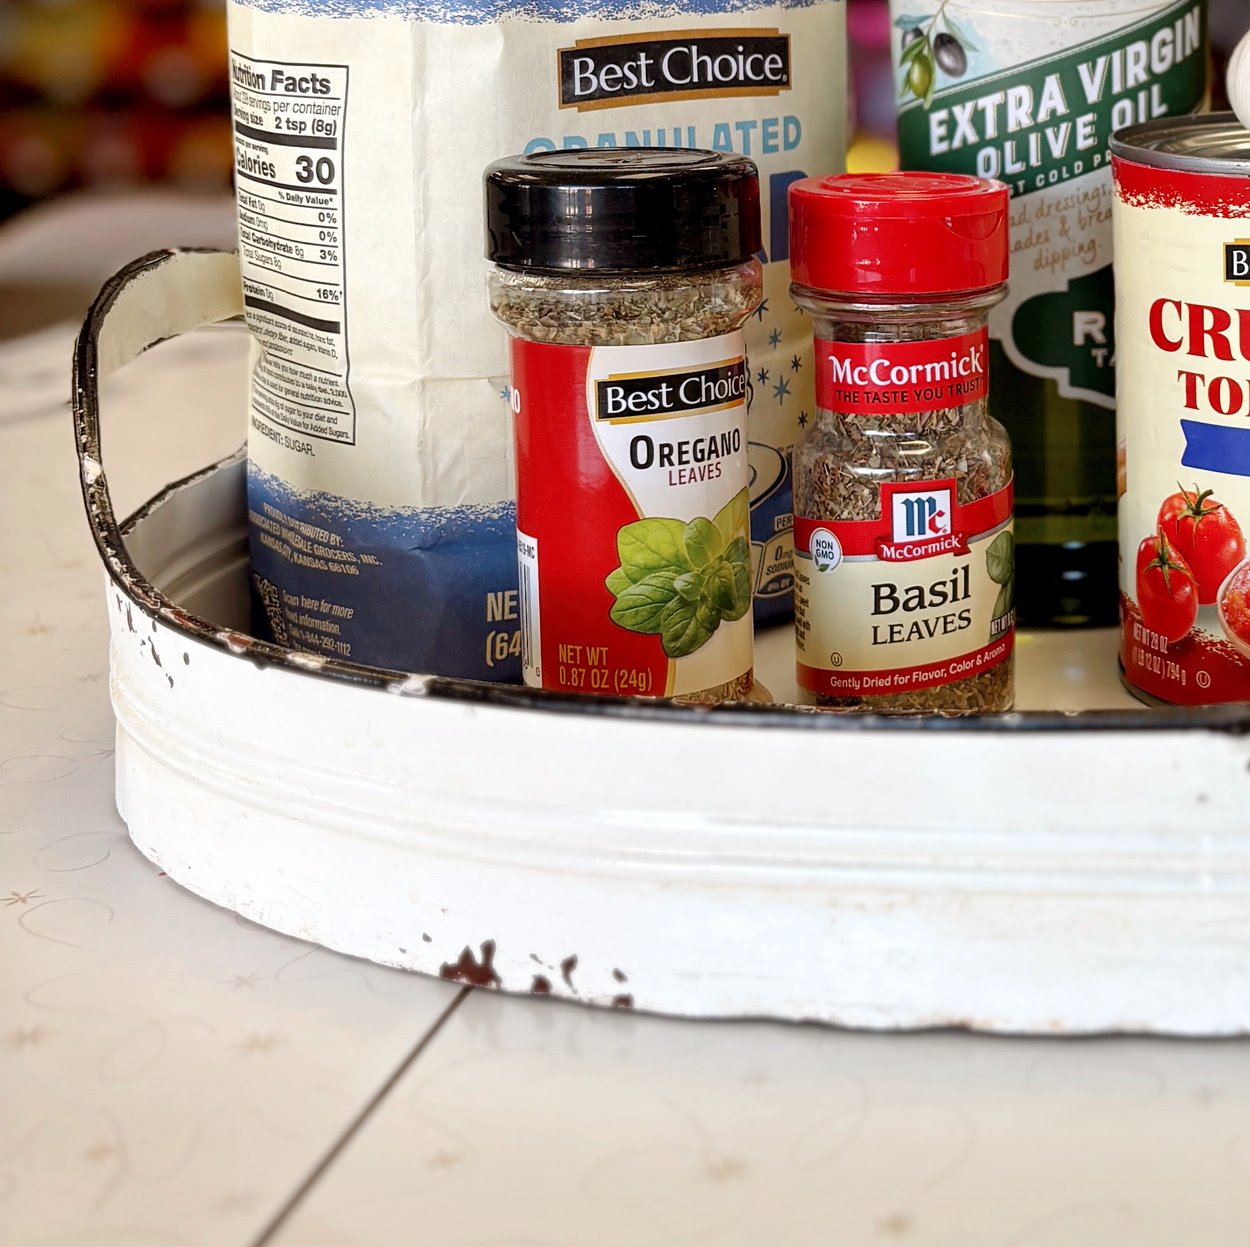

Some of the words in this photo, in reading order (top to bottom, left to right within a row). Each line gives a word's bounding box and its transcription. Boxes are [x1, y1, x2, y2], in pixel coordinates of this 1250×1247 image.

[270, 69, 331, 95] Facts
[573, 52, 655, 96] Best
[929, 73, 1070, 156] EXTRA
[1077, 5, 1200, 105] VIRGIN
[292, 101, 341, 116] container
[274, 116, 283, 130] 2
[285, 117, 307, 134] tsp
[311, 118, 337, 136] (8g)
[976, 113, 1098, 179] OLIVE
[1111, 83, 1168, 132] OIL
[295, 155, 335, 184] 30
[1036, 160, 1083, 187] COLD
[318, 212, 337, 224] 0%
[319, 231, 337, 243] 0%
[320, 250, 338, 261] 3%
[606, 382, 673, 414] Best
[836, 389, 859, 403] THE
[864, 389, 908, 403] TASTE
[913, 387, 943, 401] YOU
[668, 462, 722, 487] LEAVES
[815, 539, 833, 550] NON
[815, 549, 834, 560] GMO
[871, 564, 971, 615] Basil
[332, 604, 354, 619] more
[871, 609, 971, 645] LEAVES
[558, 643, 582, 664] NET
[586, 646, 609, 666] WT
[830, 676, 861, 690] Gently
[863, 676, 891, 688] Dried
[893, 675, 910, 685] for
[912, 669, 947, 683] Flavor,
[949, 660, 976, 674] Color
[976, 655, 982, 665] &
[983, 643, 1006, 663] Aroma
[559, 667, 586, 687] 0.87
[590, 669, 610, 689] OZ
[614, 669, 652, 692] (24g)
